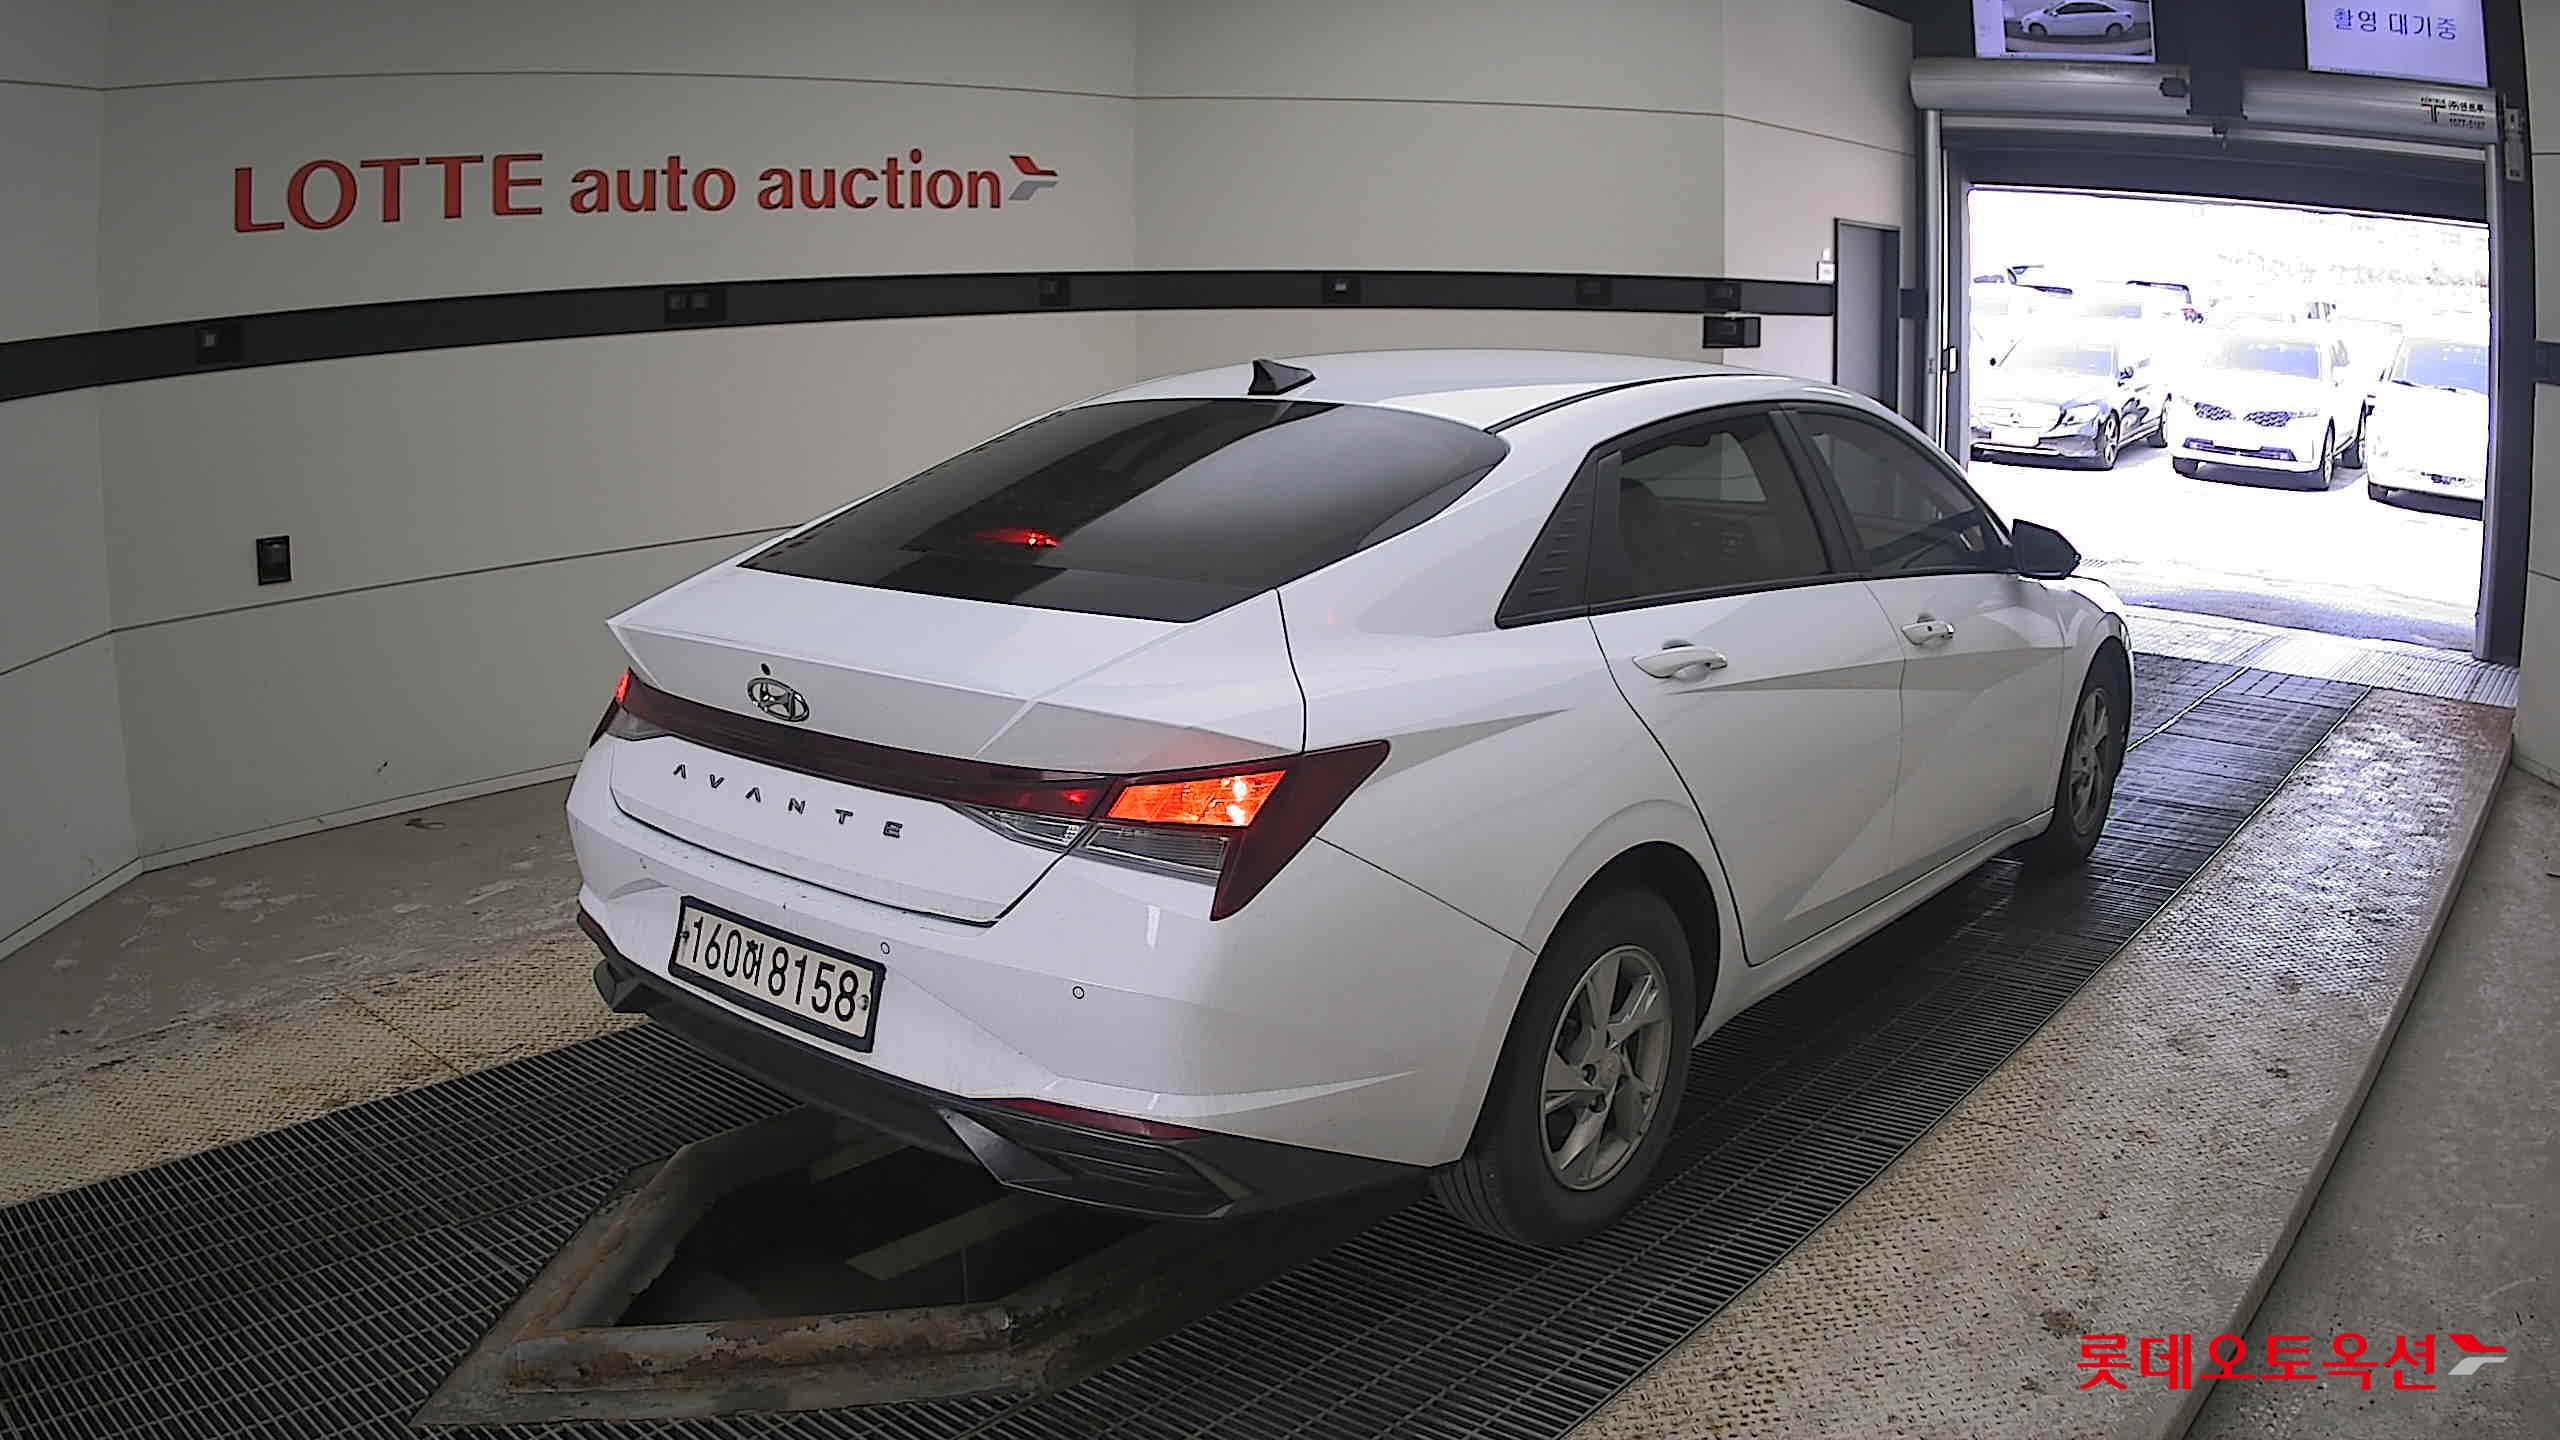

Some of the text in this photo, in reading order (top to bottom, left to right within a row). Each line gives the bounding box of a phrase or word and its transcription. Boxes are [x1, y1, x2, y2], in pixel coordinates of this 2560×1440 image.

[2389, 13, 2457, 40] 대기중
[234, 147, 1001, 233] LOTTE auto auction
[673, 763, 904, 839] AVANTE
